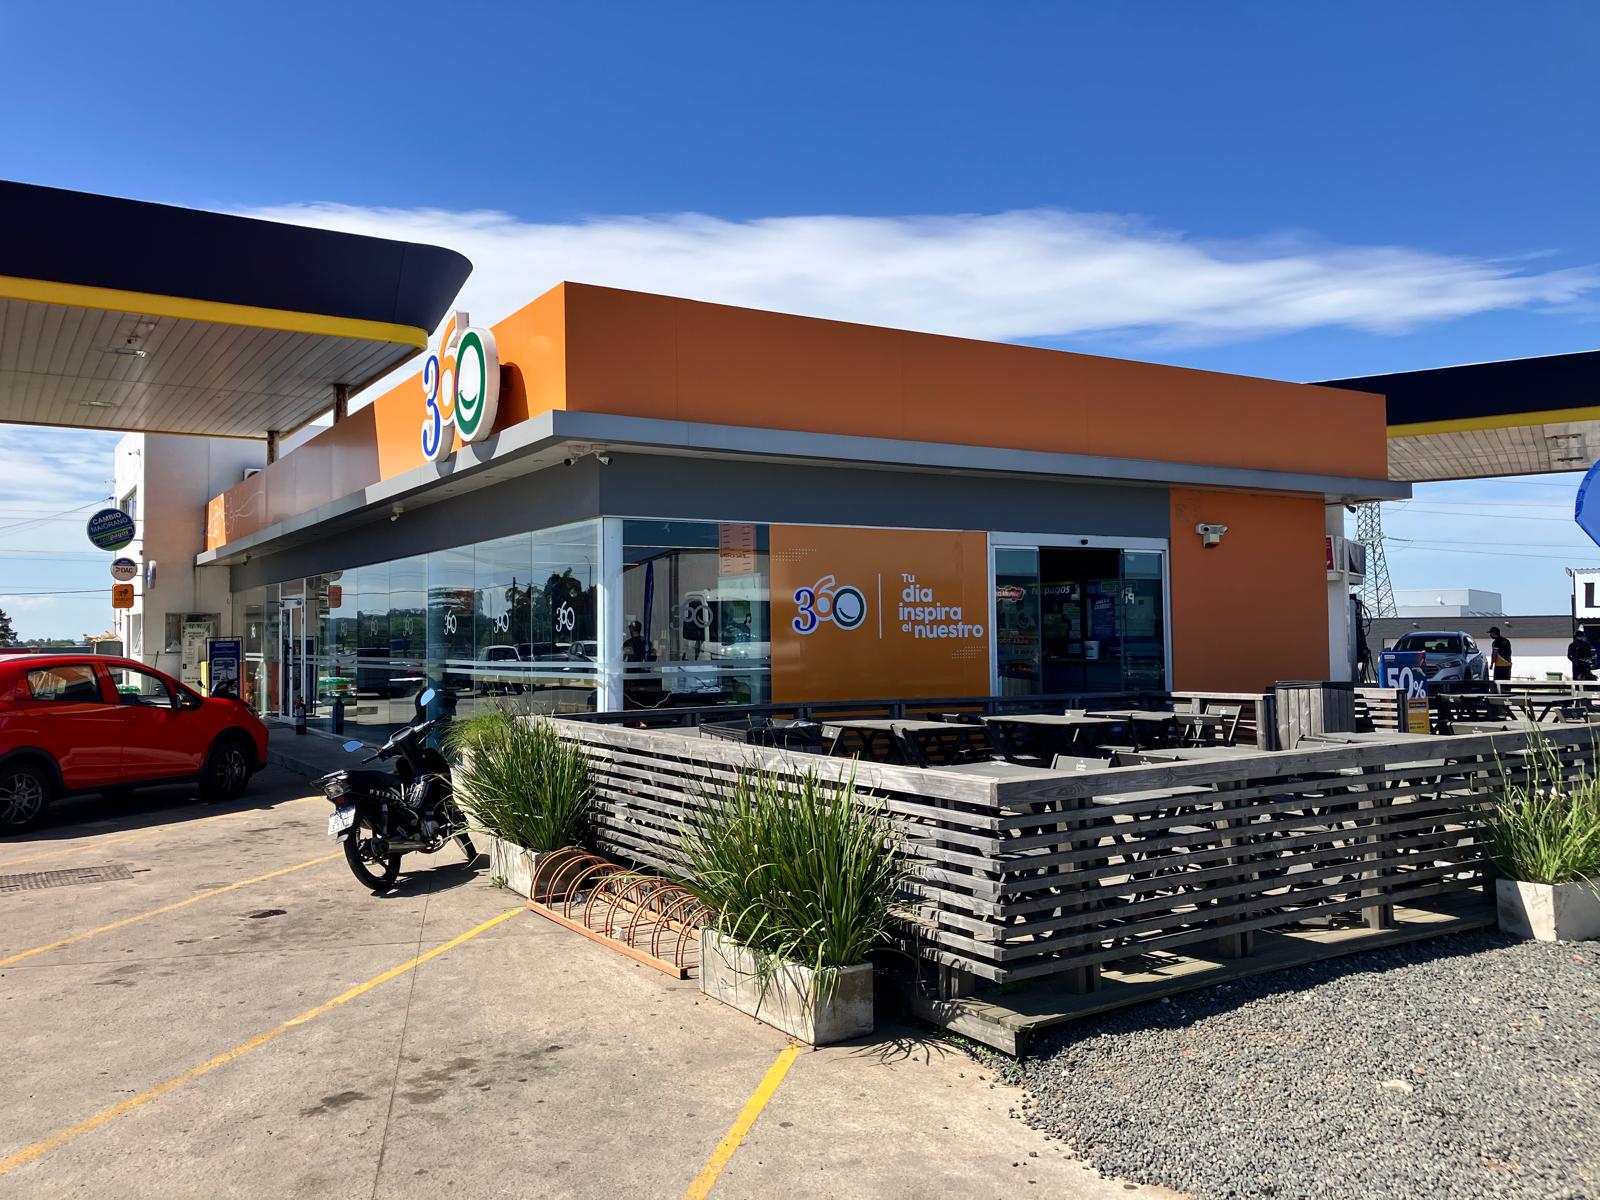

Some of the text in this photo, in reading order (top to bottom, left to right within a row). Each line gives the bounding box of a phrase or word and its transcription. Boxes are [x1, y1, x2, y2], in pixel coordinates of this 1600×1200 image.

[421, 311, 488, 462] 360
[92, 512, 121, 525] CAMBIO
[901, 573, 915, 583] Tu
[556, 601, 575, 632] 360
[792, 575, 867, 635] 360
[898, 602, 962, 624] inspira
[444, 610, 457, 635] 360
[902, 621, 984, 638] el nuestro
[1387, 667, 1426, 698] 50%
